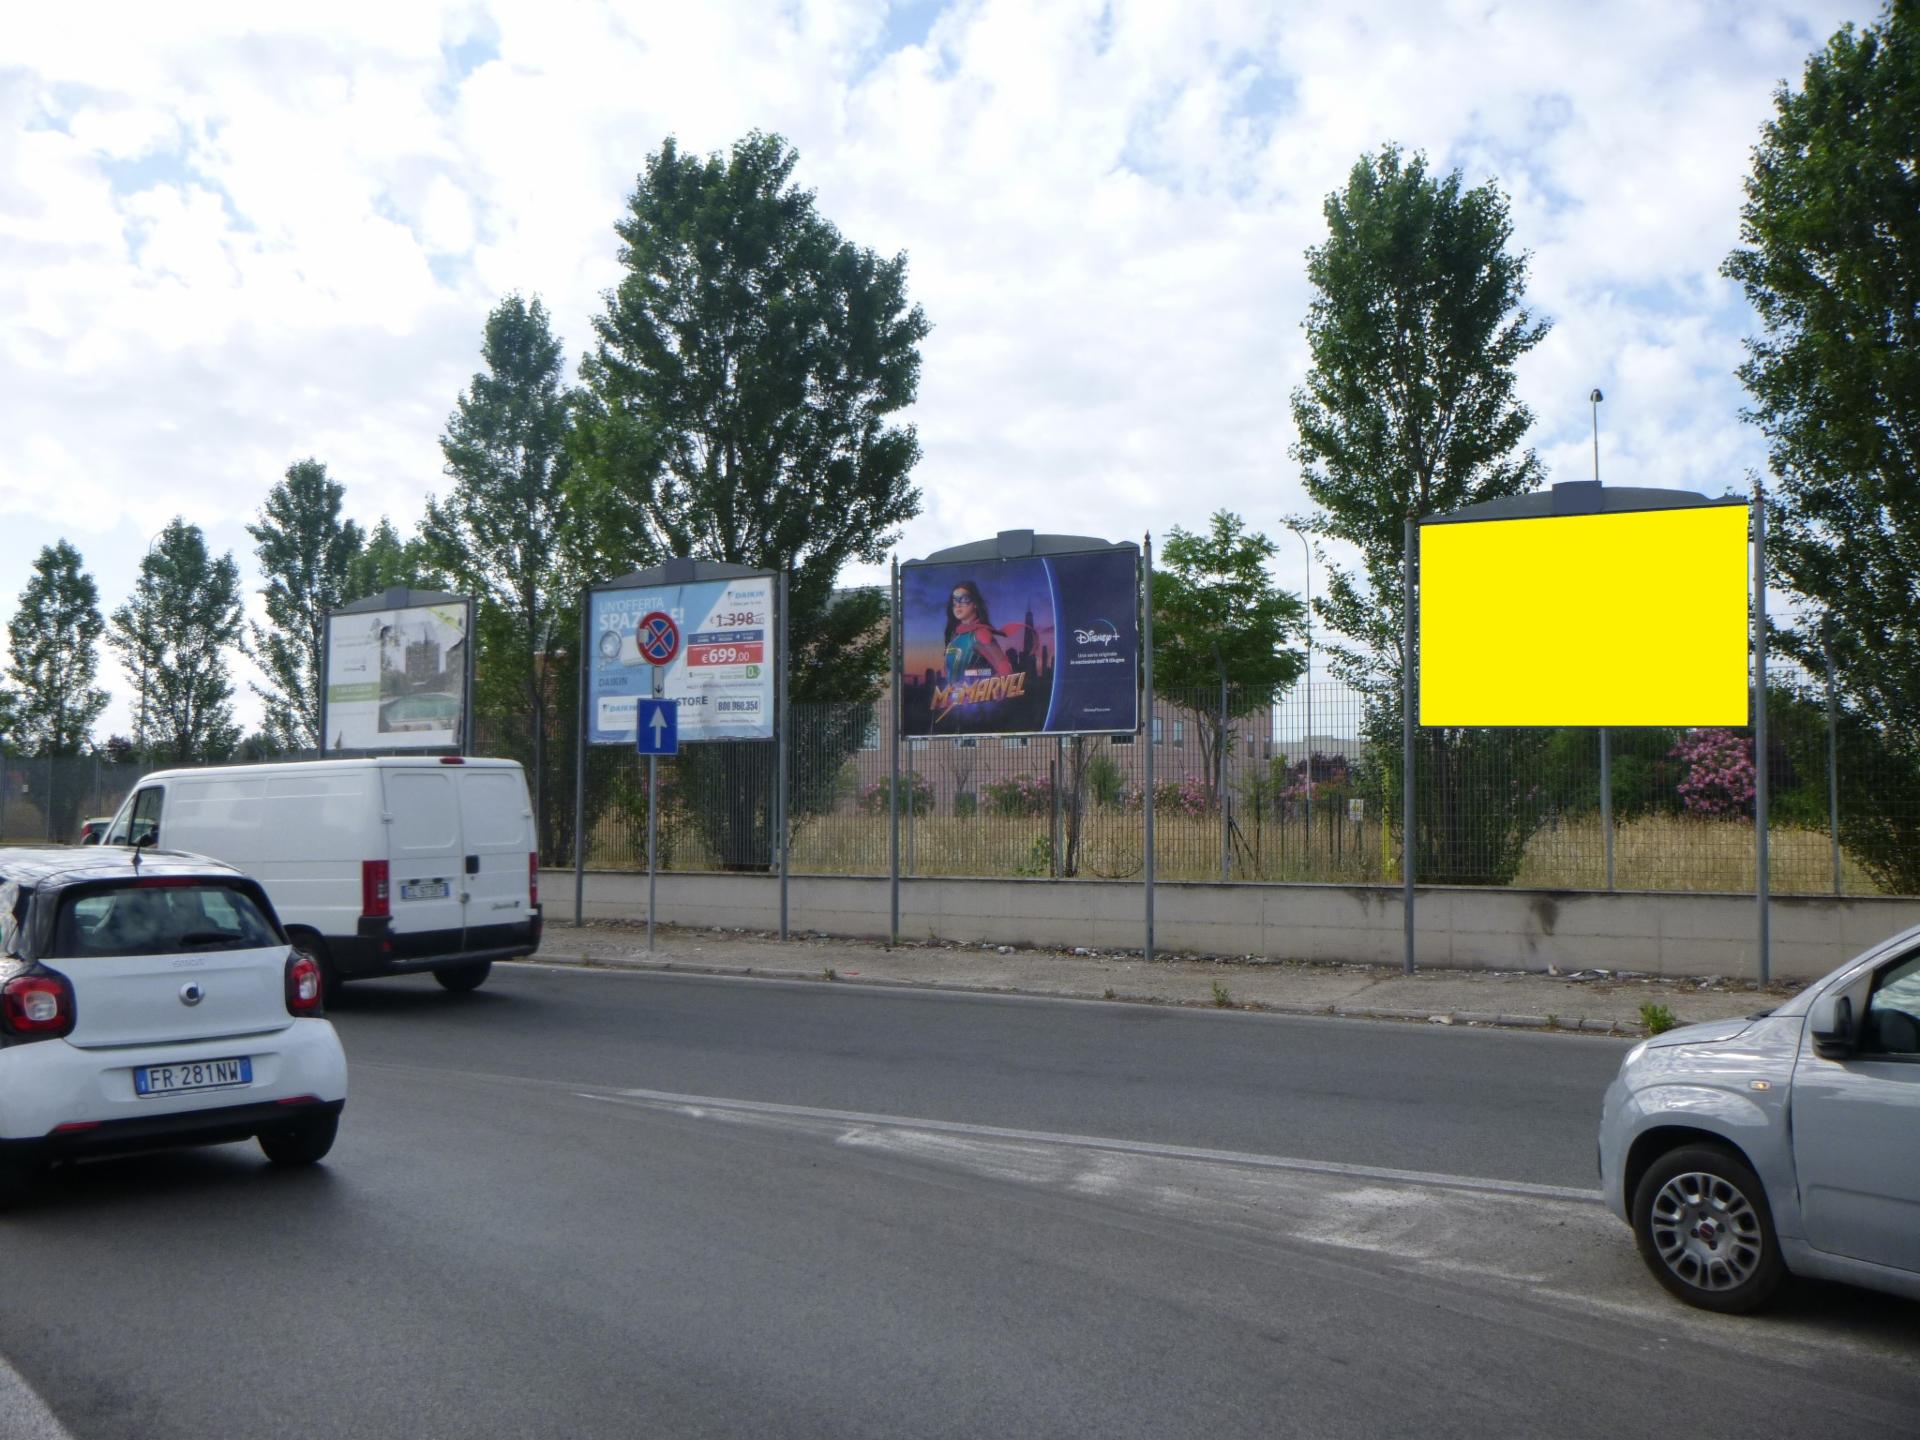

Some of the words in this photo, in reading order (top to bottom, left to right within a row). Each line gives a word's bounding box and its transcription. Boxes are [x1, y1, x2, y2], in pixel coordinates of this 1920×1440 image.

[734, 591, 765, 599] DAIKIN
[600, 597, 664, 613] UN'OFFERTA
[600, 607, 685, 631] SPAZE!
[599, 677, 628, 687] DAIKIN
[960, 672, 1026, 704] MARVEL
[675, 696, 709, 706] STORE
[150, 1069, 174, 1089] FR
